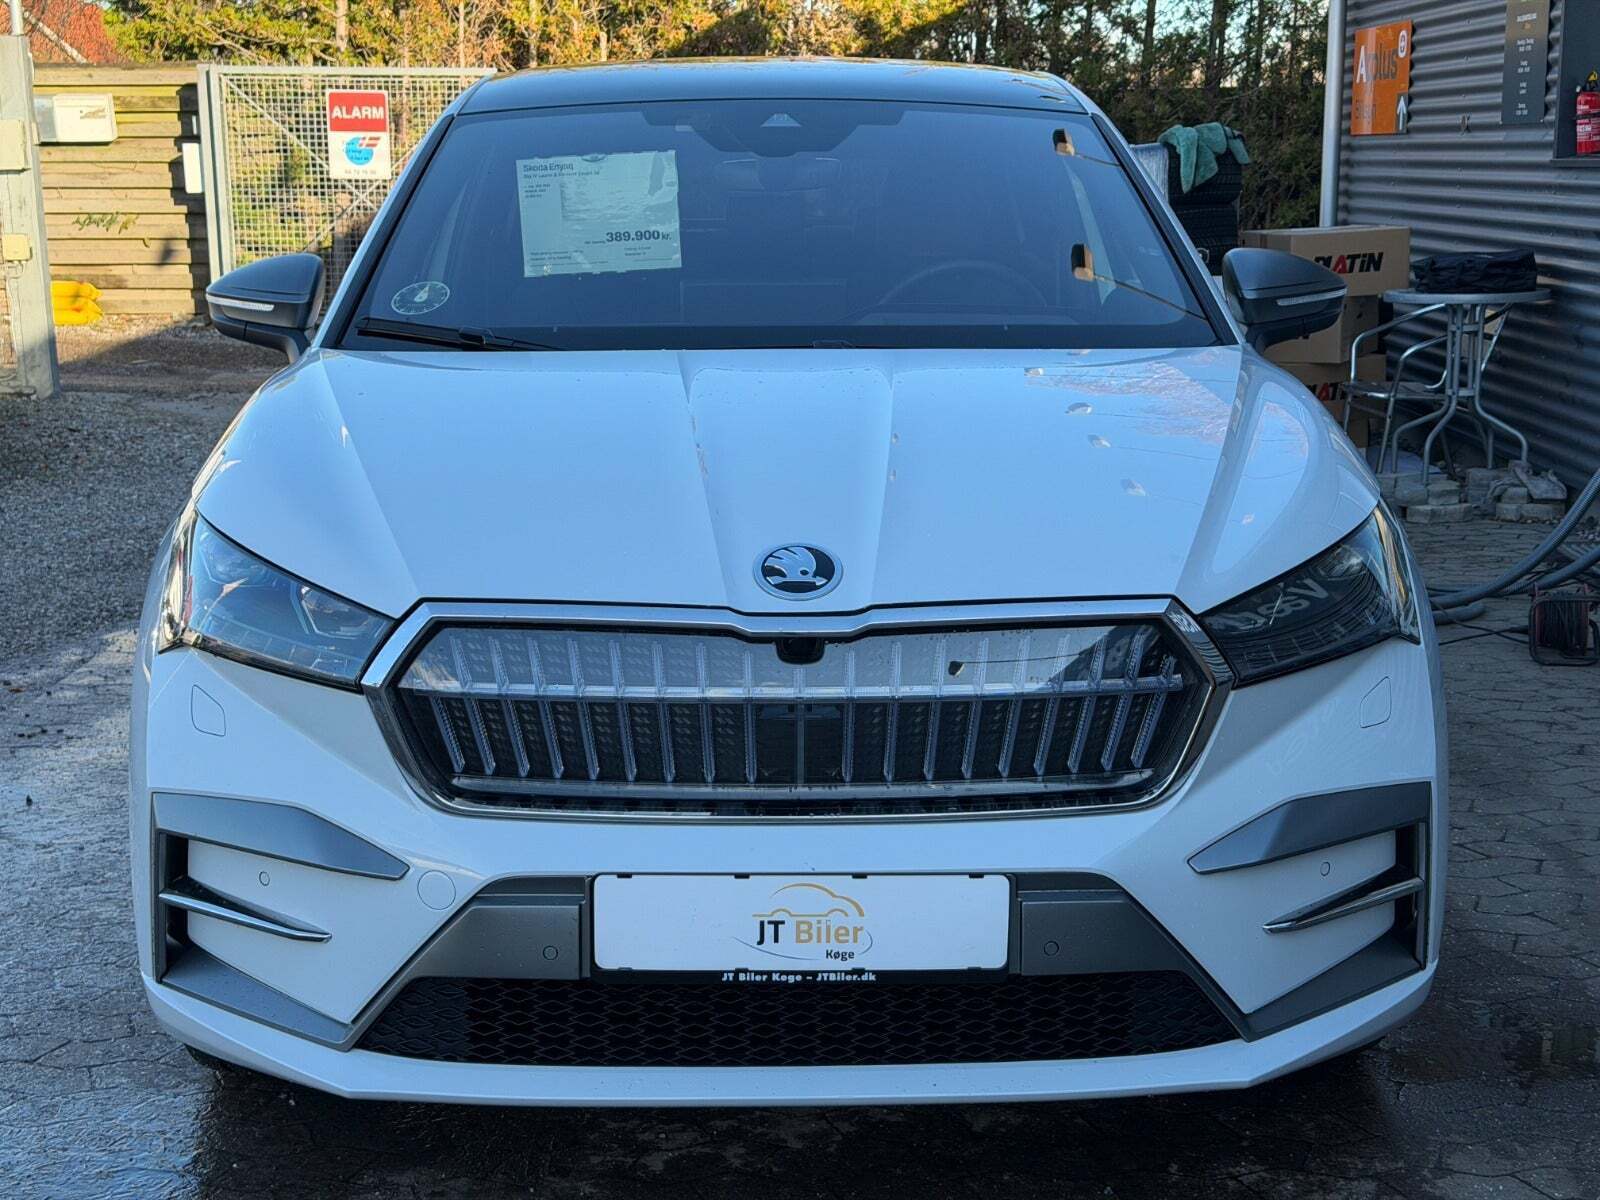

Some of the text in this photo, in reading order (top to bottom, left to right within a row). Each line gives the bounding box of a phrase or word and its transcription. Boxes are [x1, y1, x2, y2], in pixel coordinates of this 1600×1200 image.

[331, 106, 384, 119] ALARM
[606, 230, 672, 242] 389.900 kr.
[757, 920, 864, 945] JT Biler
[825, 949, 855, 961] Køge
[721, 972, 734, 982] JT
[738, 972, 768, 982] Biler
[816, 972, 877, 982] JTBiler.dk
